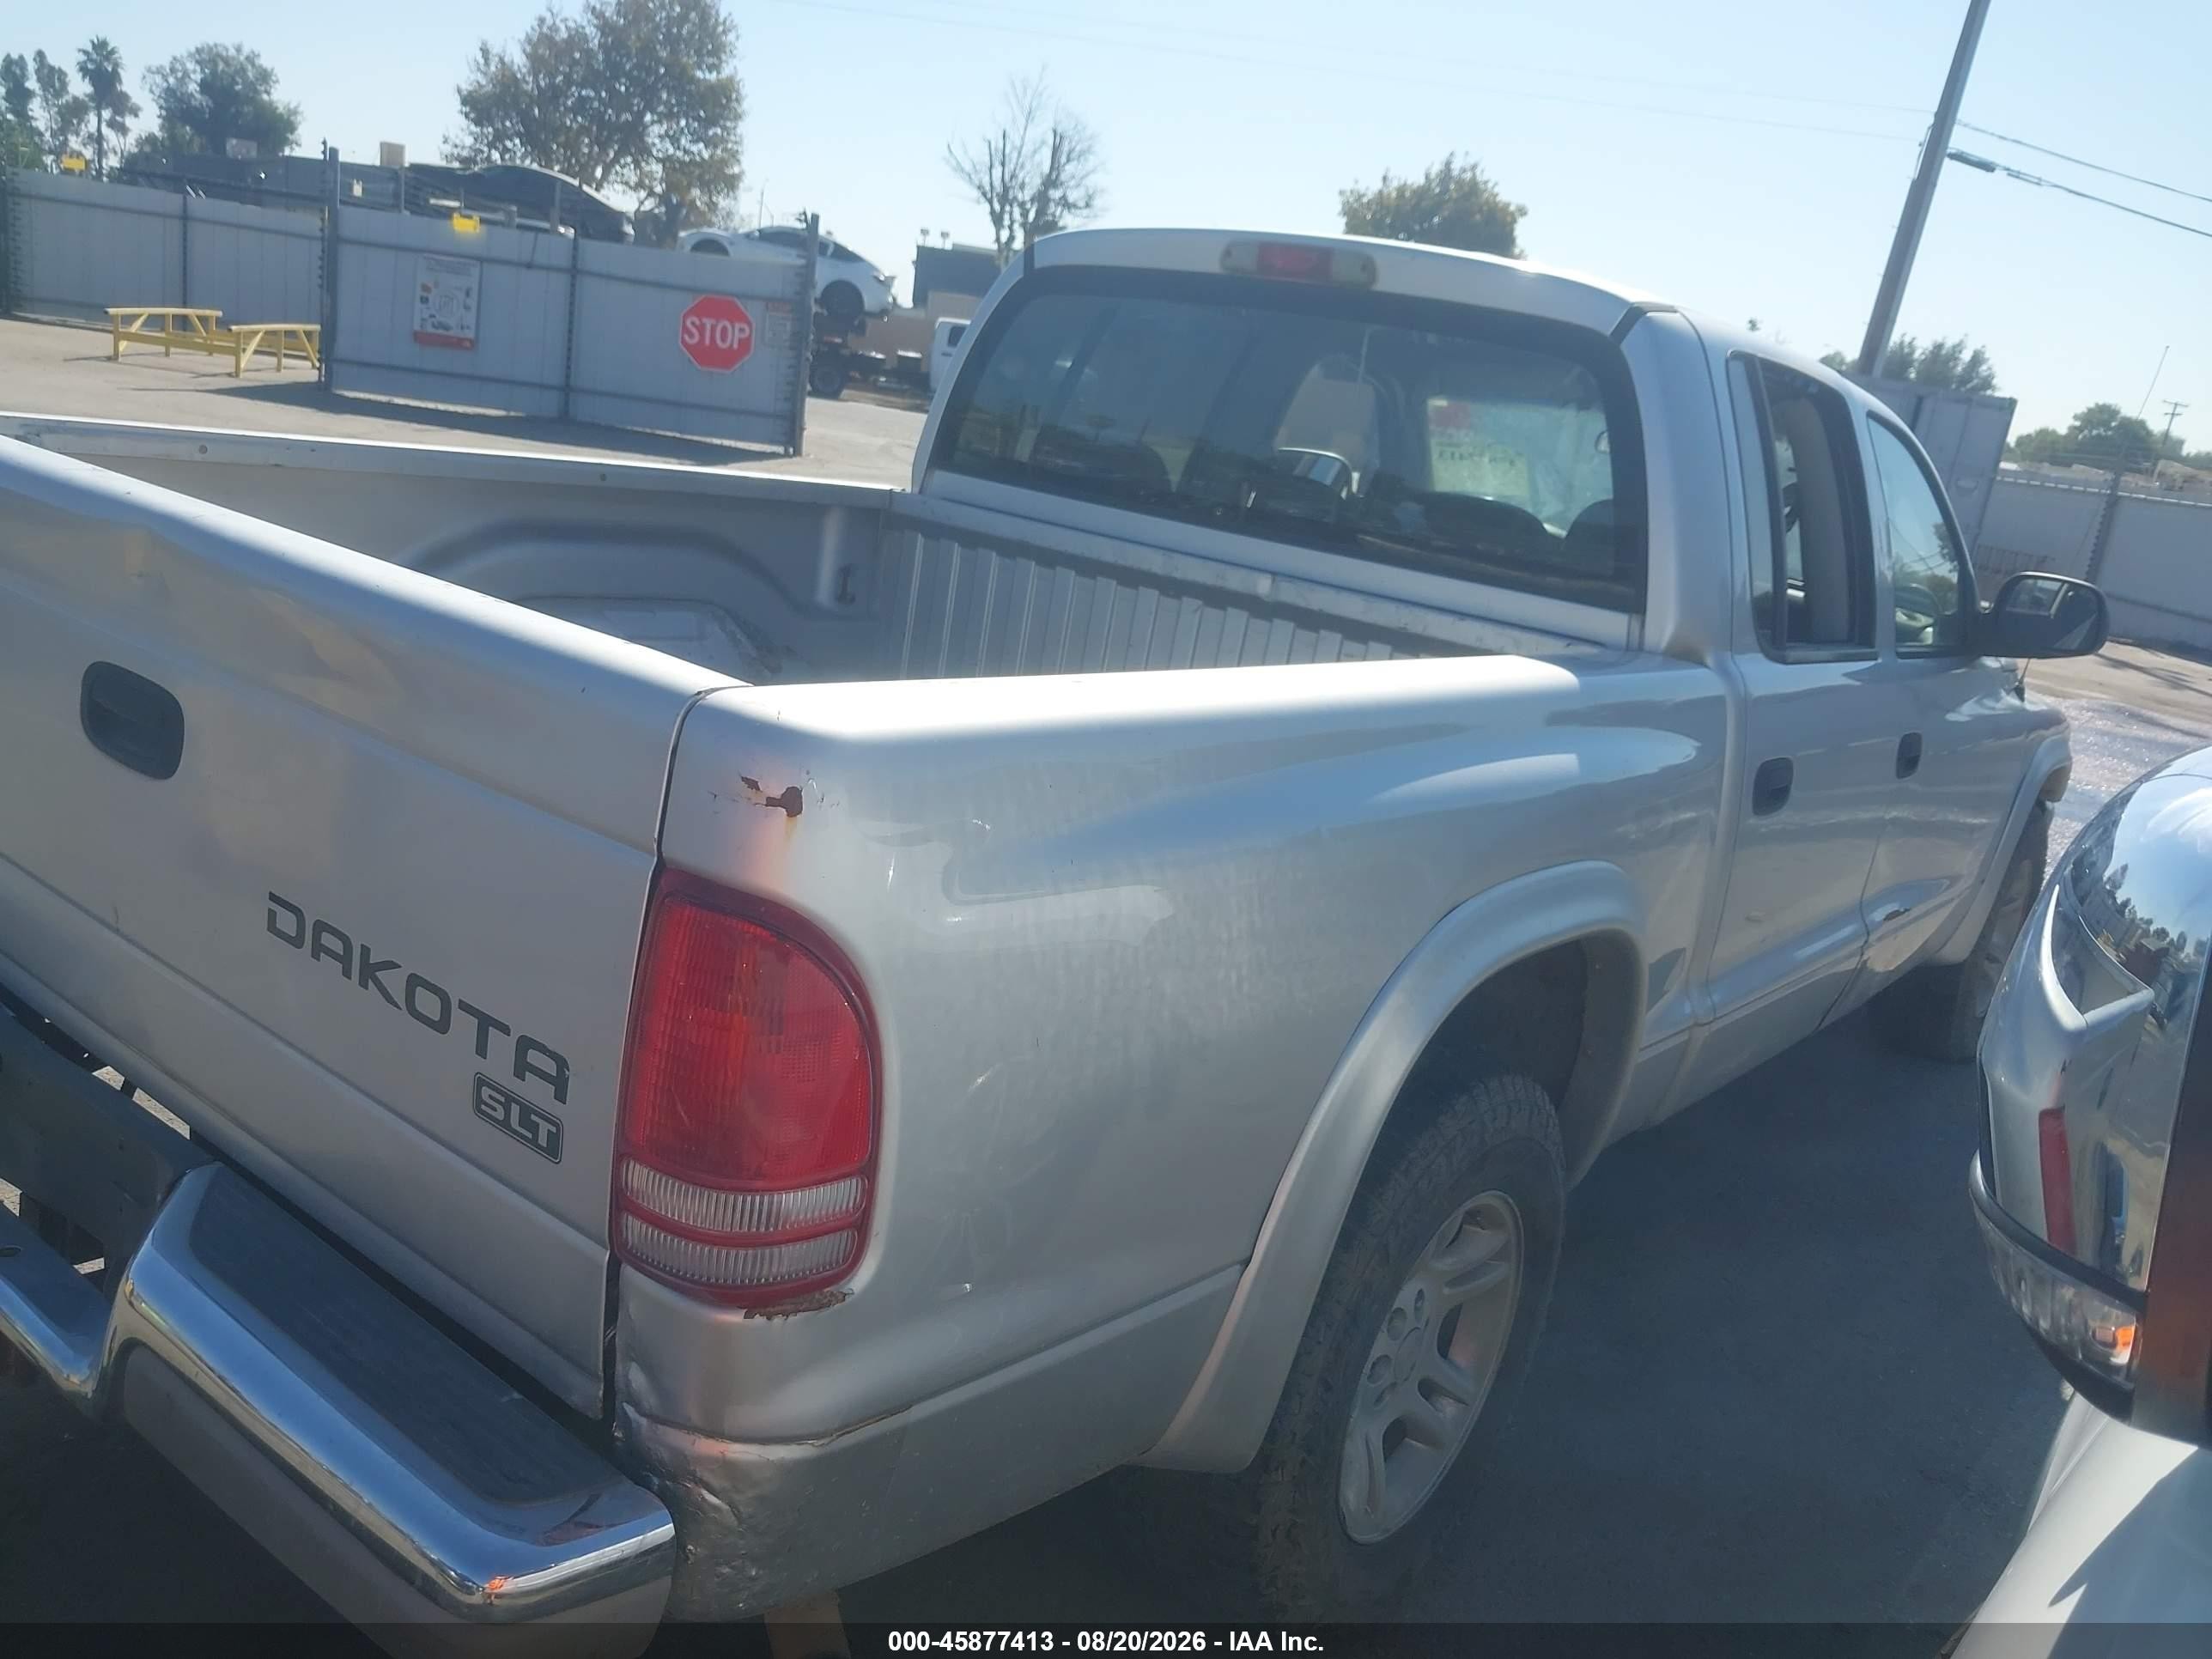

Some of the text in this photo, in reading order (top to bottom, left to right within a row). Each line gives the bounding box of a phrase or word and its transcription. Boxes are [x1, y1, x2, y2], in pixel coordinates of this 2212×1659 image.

[684, 316, 750, 349] STOP
[266, 890, 570, 1105] DAKOTA
[479, 1084, 558, 1149] SLT
